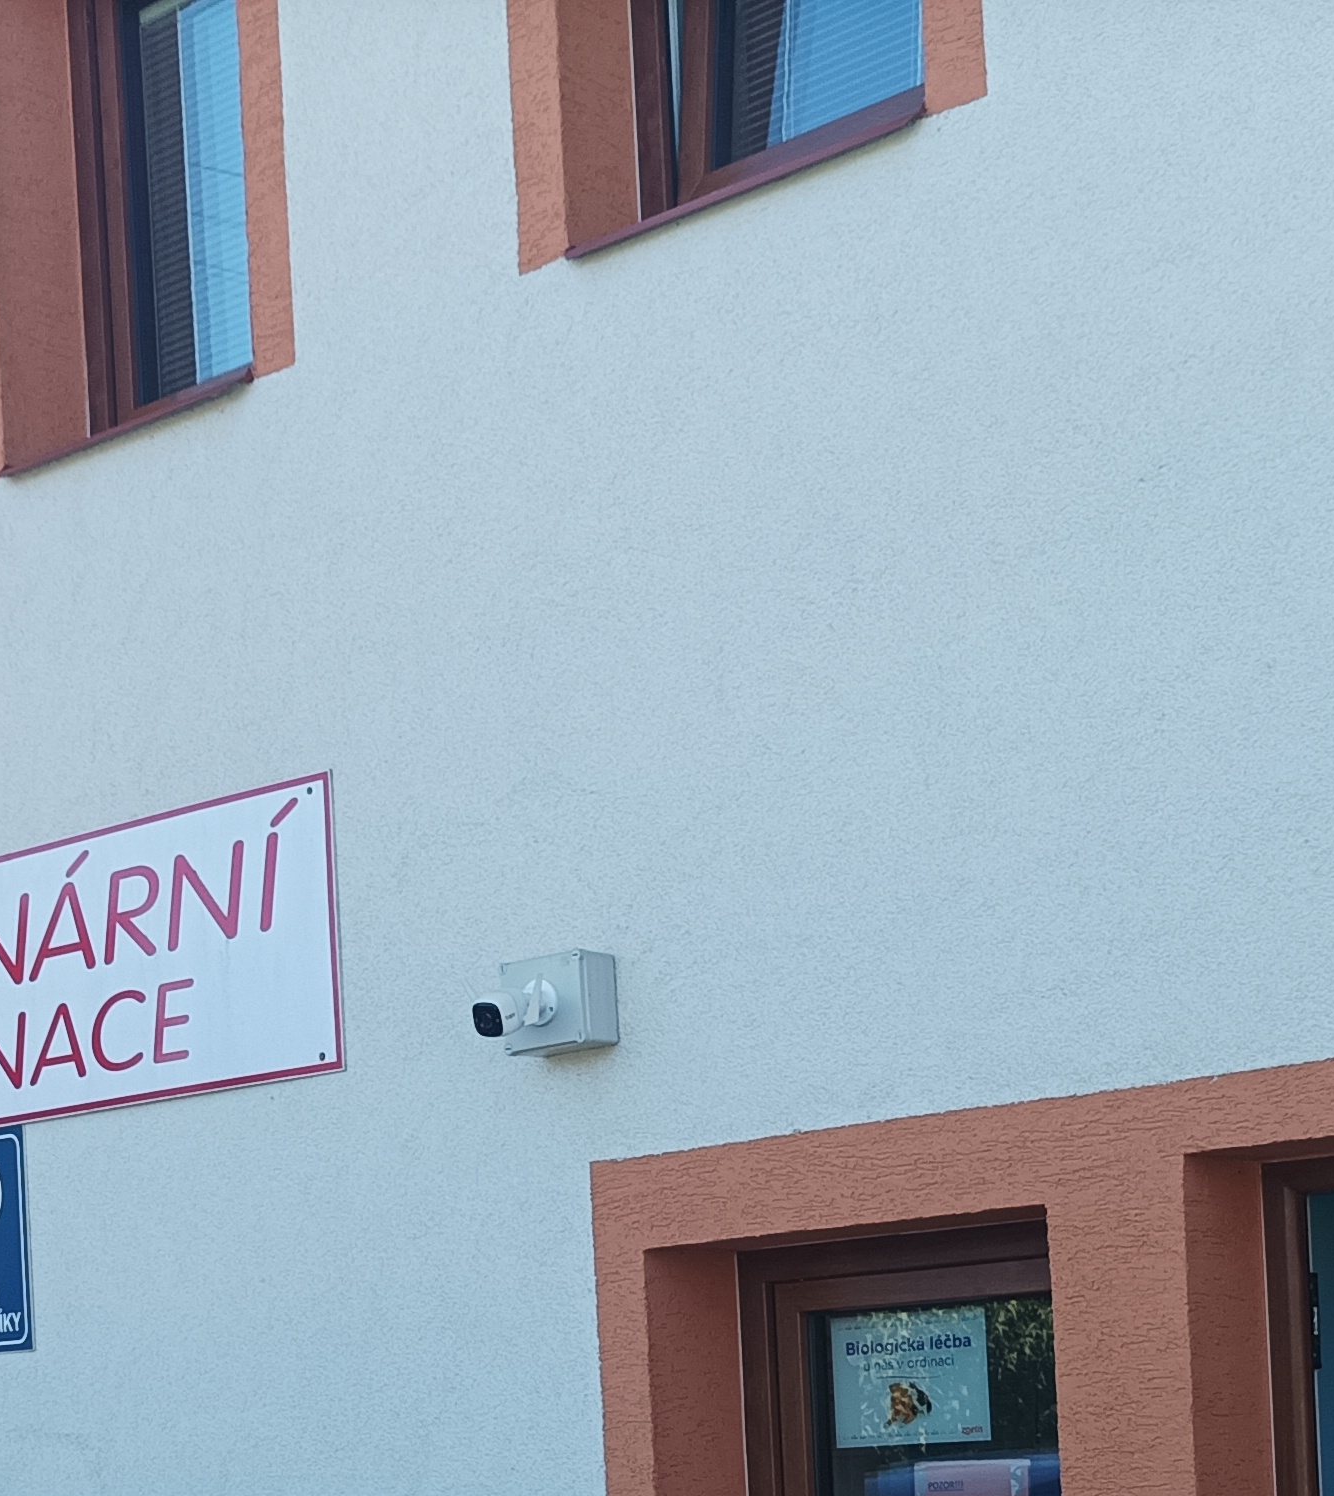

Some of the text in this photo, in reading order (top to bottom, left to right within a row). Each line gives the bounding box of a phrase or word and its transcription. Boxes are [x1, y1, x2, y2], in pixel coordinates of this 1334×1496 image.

[845, 1333, 972, 1356] Biologická léčba
[874, 1358, 894, 1371] nás
[907, 1355, 955, 1369] ordinaci
